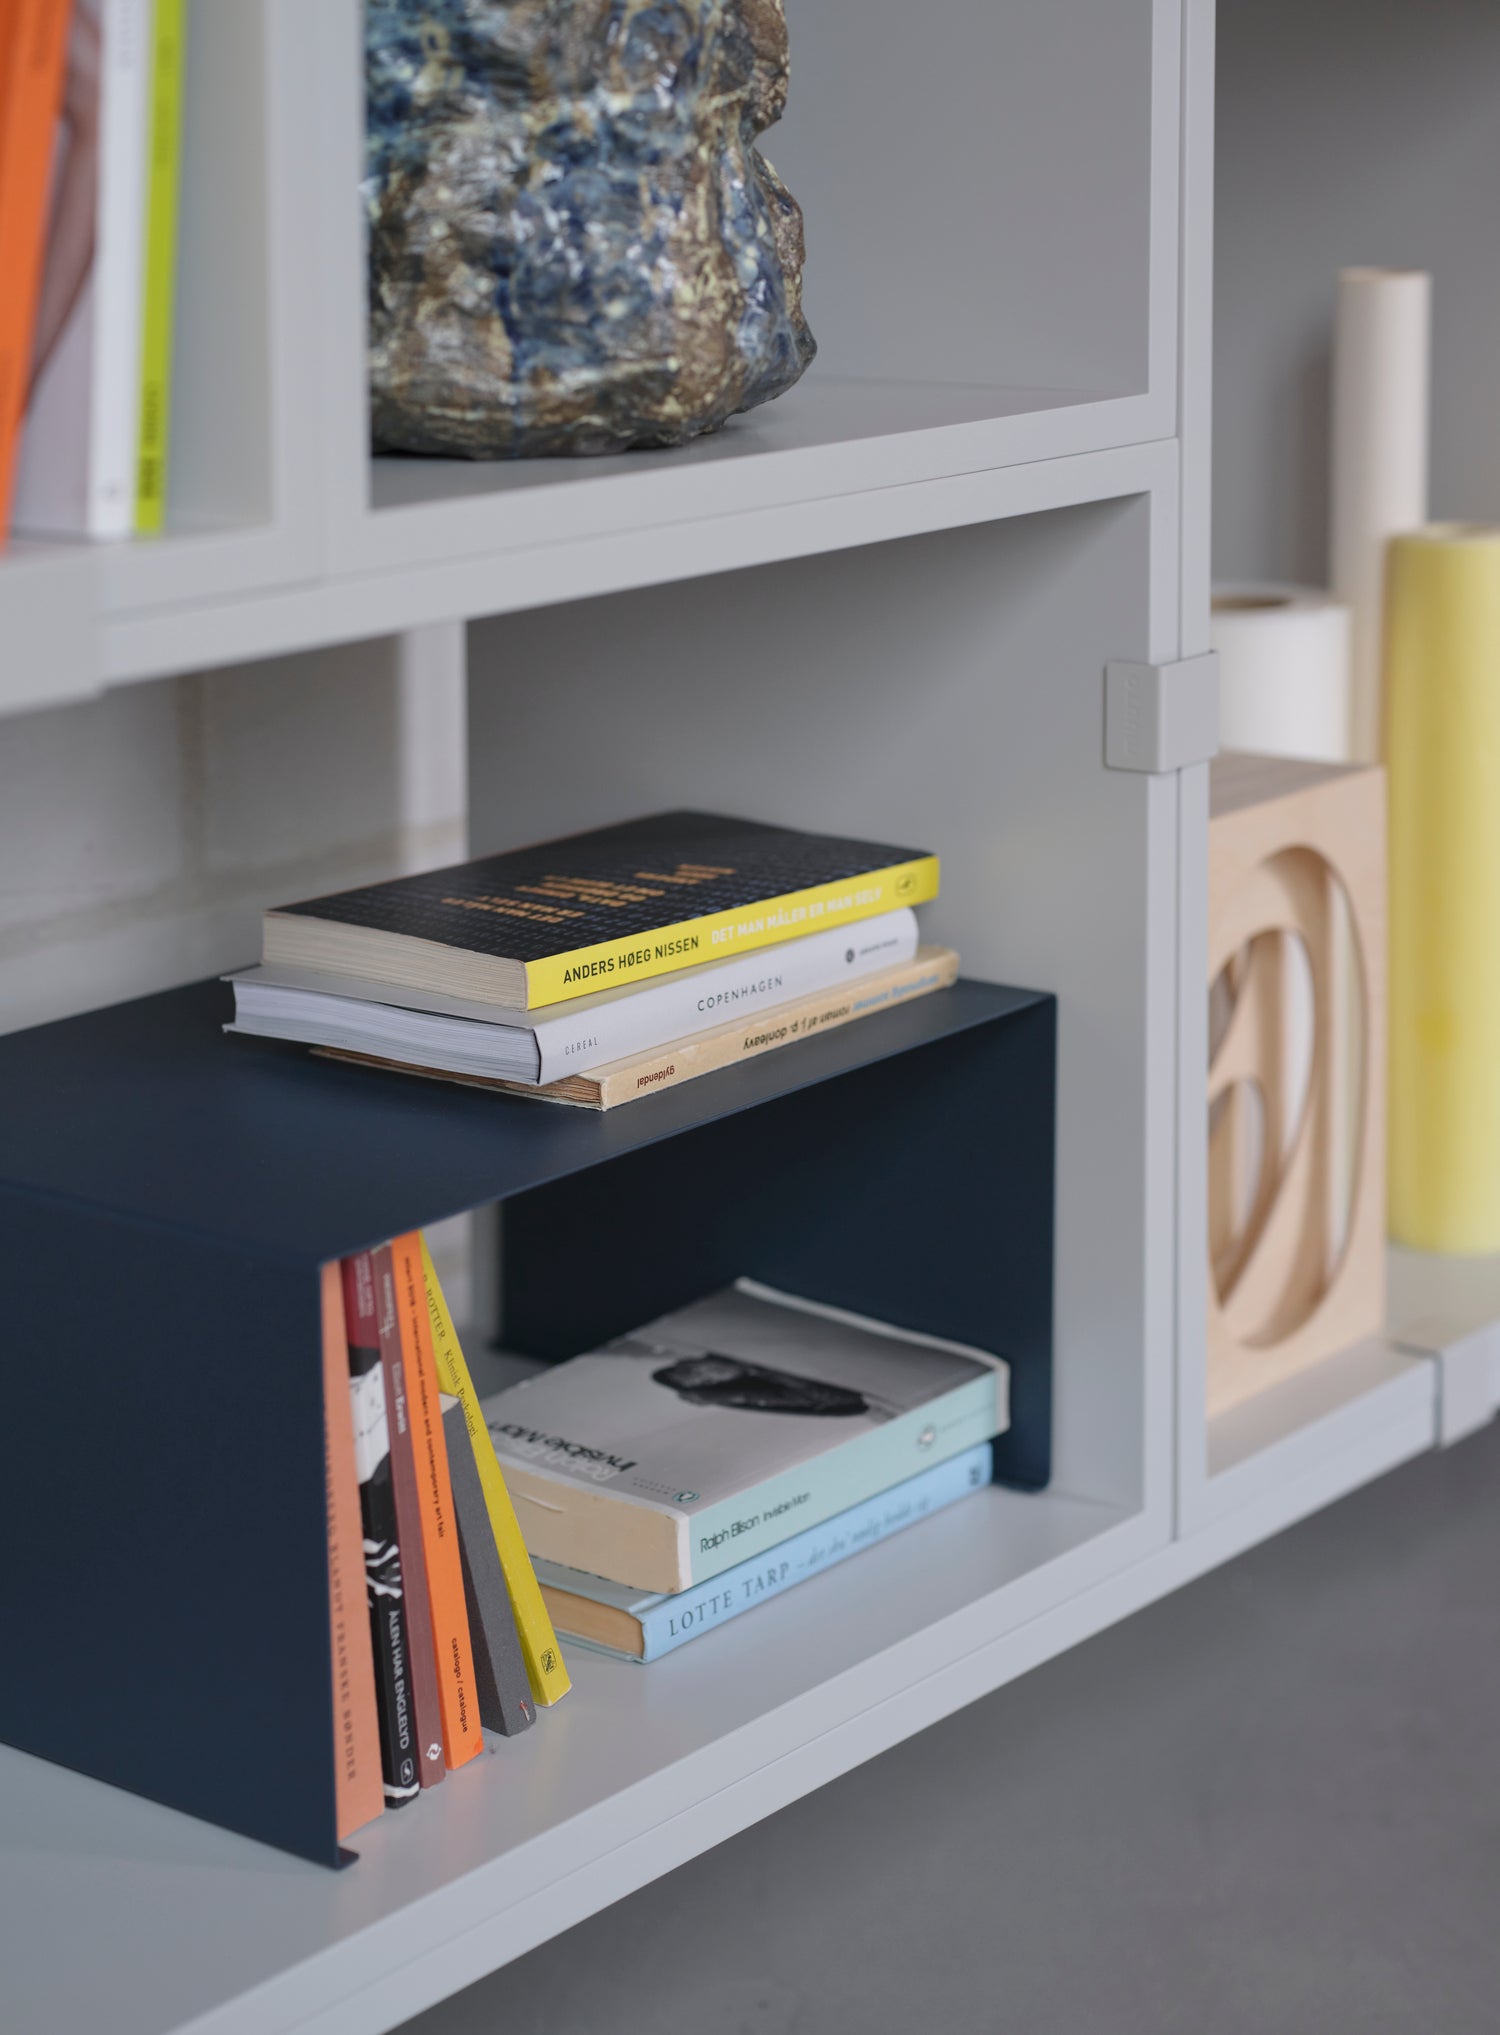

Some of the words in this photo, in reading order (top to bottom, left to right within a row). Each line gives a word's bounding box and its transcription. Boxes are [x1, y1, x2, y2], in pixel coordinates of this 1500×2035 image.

[711, 927, 735, 945] DET
[737, 920, 765, 938] MAN
[767, 907, 807, 932] MÅLER
[810, 902, 825, 918] ER
[827, 895, 853, 913] MAN
[855, 887, 882, 906] SELV
[563, 958, 615, 985] ANDERS
[618, 949, 652, 970] HØEG
[655, 936, 699, 960] NISSEN
[697, 976, 783, 1012] COPENHAGEN
[564, 1037, 599, 1056] CEREAL
[743, 1027, 788, 1050] donleavy
[637, 1065, 675, 1089] gyldendal
[426, 1288, 446, 1342] ROTTER
[444, 1348, 461, 1387] Klinisk
[420, 1379, 428, 1416] modern
[424, 1418, 432, 1436] and
[427, 1438, 439, 1504] contemporary
[545, 1436, 638, 1473] Invisible
[700, 1529, 730, 1553] Ralph
[730, 1513, 761, 1538] Ellison
[763, 1500, 792, 1522] Invisible
[792, 1491, 811, 1507] Man
[669, 1590, 733, 1637] LOTTE
[742, 1561, 790, 1598] TARP
[336, 1623, 351, 1703] FRANSKE
[391, 1647, 404, 1680] HAR
[451, 1637, 462, 1678] catalogo
[457, 1686, 468, 1734] catalogue
[394, 1679, 410, 1750] ENGLELYD
[343, 1710, 357, 1781] BØNDER
